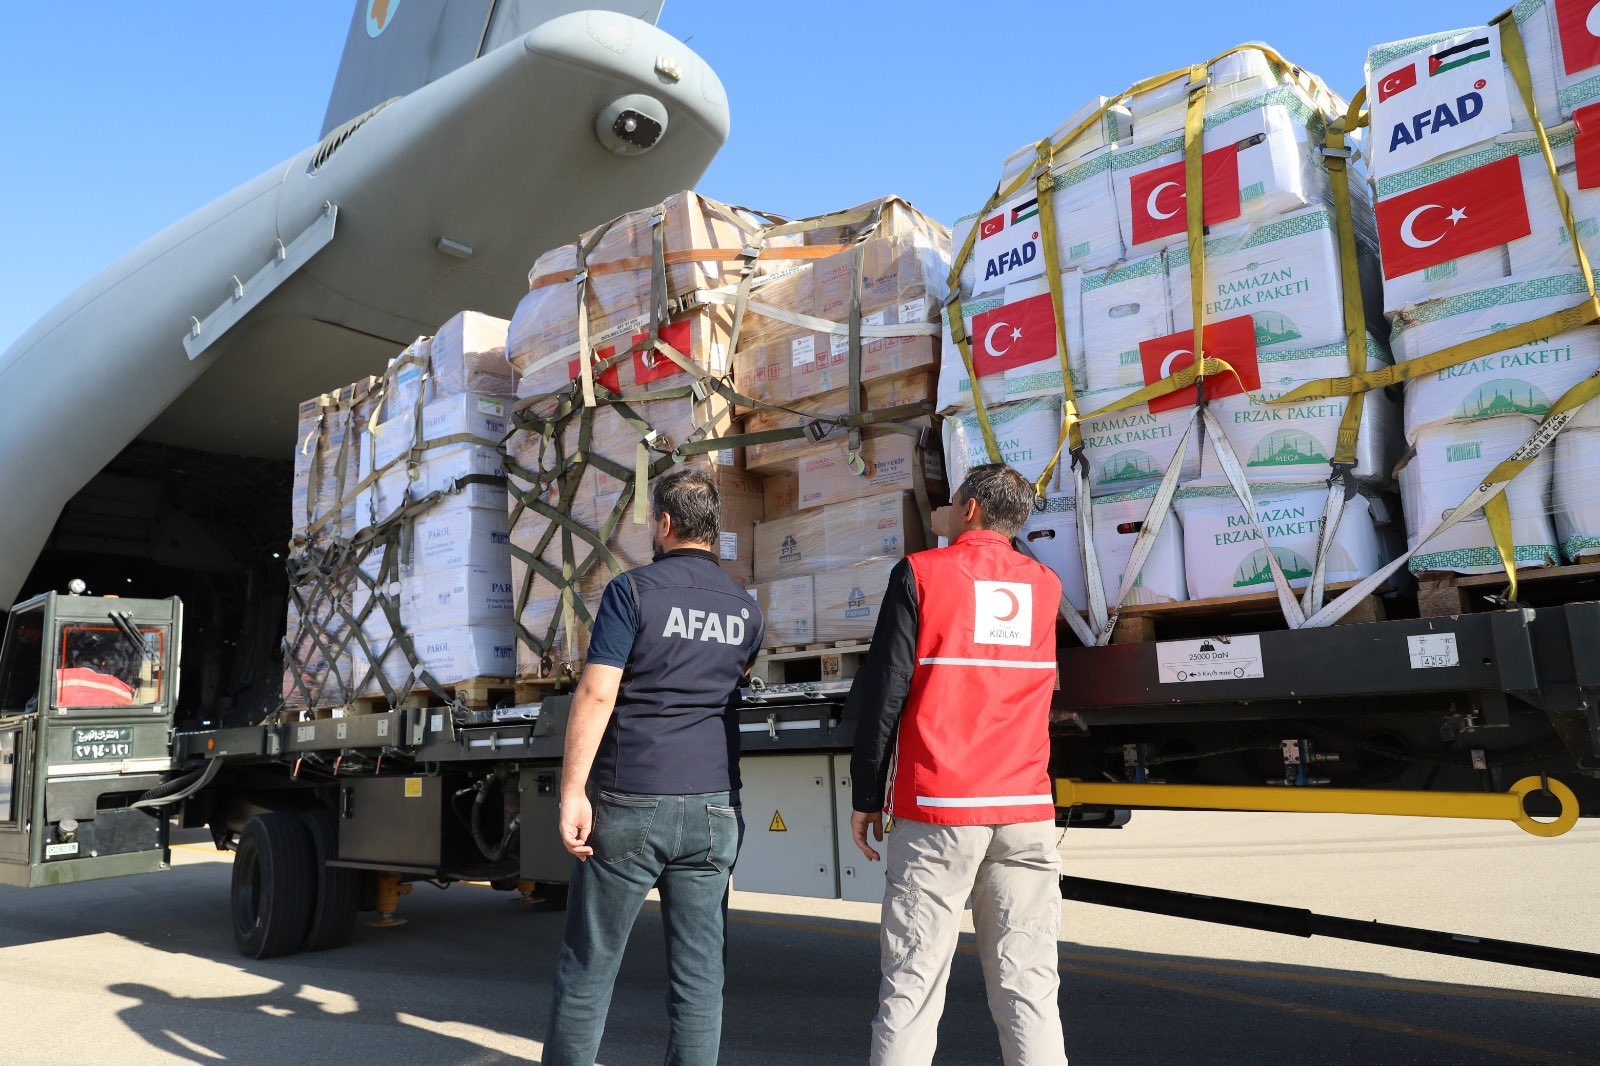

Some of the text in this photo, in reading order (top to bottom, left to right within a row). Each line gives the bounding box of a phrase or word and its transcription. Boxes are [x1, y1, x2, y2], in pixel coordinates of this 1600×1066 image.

[1388, 91, 1484, 154] AFAD
[984, 240, 1037, 282] AFAD
[1217, 266, 1293, 296] RAMAZAN
[1205, 277, 1310, 315] ERZAK PAKETİ
[1256, 334, 1272, 344] EGA
[1438, 344, 1571, 381] ERZAK PAKETİ
[1091, 412, 1158, 434] RAMAZAN
[1234, 401, 1344, 424] ERZAK PAKETİ
[1084, 422, 1174, 450] ERZAK PAKETİ
[1004, 448, 1033, 464] KETİ
[1214, 517, 1325, 546] ERZAK PAKETİ
[491, 582, 513, 593] PAR
[662, 606, 745, 646] AFAD
[989, 629, 1020, 639] KIZILAY
[427, 642, 450, 654] PAROL
[1188, 652, 1229, 661] 25000 DaN
